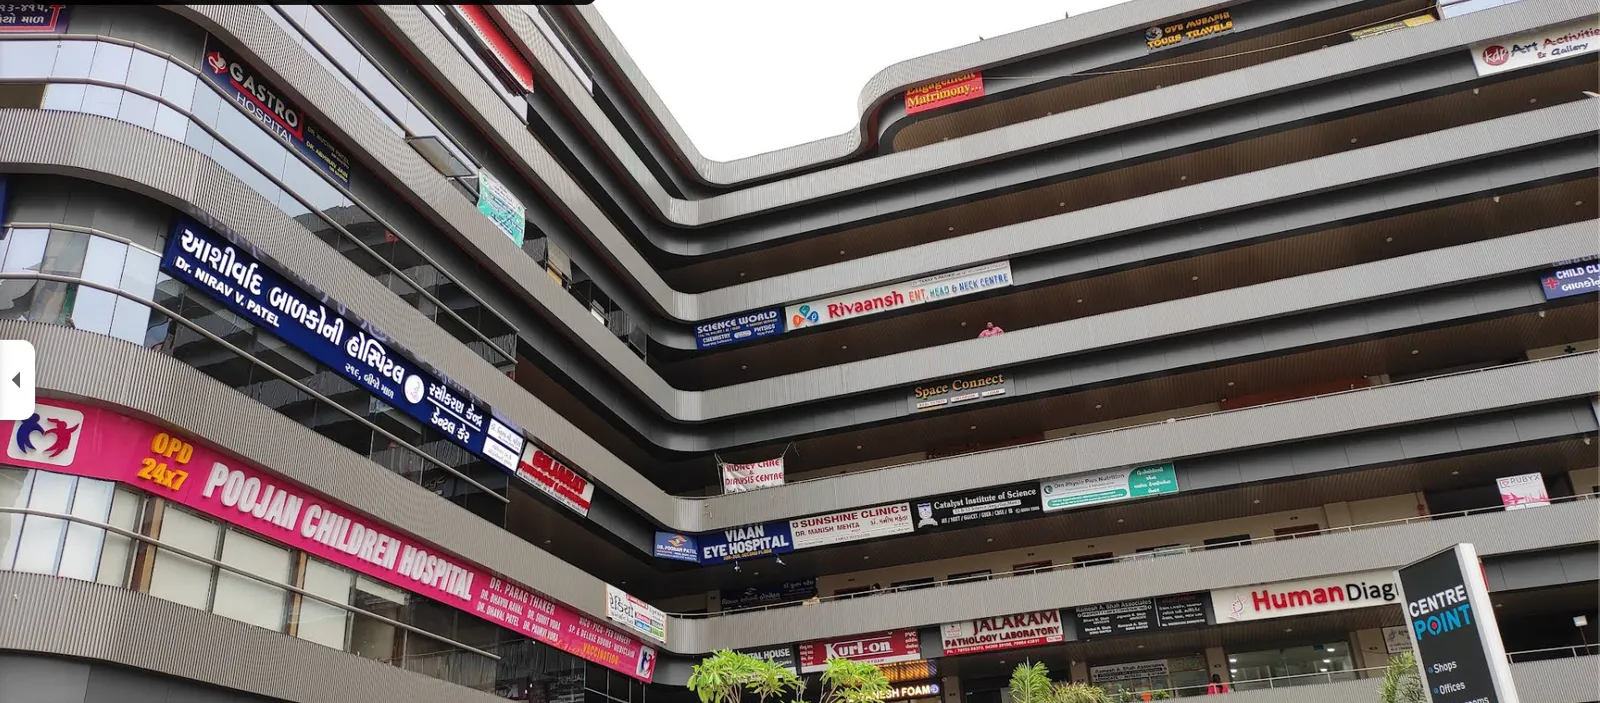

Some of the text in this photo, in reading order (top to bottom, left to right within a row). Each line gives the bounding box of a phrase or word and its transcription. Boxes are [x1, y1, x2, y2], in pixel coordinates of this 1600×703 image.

[21, 16, 44, 24] માળ
[1147, 21, 1233, 48] TOURS TRAVELS
[1511, 41, 1538, 57] Art
[1551, 43, 1588, 56] Gallery
[229, 62, 298, 128] GASTRO
[236, 91, 295, 149] HOSPITAL
[1556, 267, 1584, 279] CHILD
[175, 256, 280, 327] Dr. NIRAV V. PATEL
[1561, 276, 1600, 291] બાળકો
[827, 291, 904, 318] Rivaansh
[929, 286, 950, 298] HEAD
[952, 284, 957, 292] &
[958, 280, 978, 291] NECK
[980, 273, 1008, 287] CENTRE
[180, 229, 405, 384] આશીર્વાદ બાળકોની હોસ્પિટલ
[697, 319, 736, 334] SCIENCE
[738, 311, 777, 325] WORLD
[702, 333, 731, 343] CHEMISTRY
[754, 324, 775, 332] PHYSICS
[380, 384, 395, 399] માળ
[915, 373, 1005, 398] Space Connect
[456, 424, 470, 444] કેર
[151, 432, 193, 464] OPD
[137, 457, 188, 491] 24x7
[755, 472, 783, 482] CENTRE
[1510, 474, 1540, 484] RUBYX
[934, 489, 1037, 510] Catalyst Institute of Science
[801, 506, 899, 528] SUNSHINE CLINIC
[202, 461, 474, 601] POOJAN CHILDREN HOSPITAL
[725, 525, 765, 542] VIAAN
[808, 526, 834, 535] MANISH
[836, 522, 860, 531] MEHTA
[703, 544, 728, 559] EYE
[729, 534, 789, 555] HOSPITAL
[480, 589, 489, 601] DR.
[490, 577, 556, 615] DR. PARAG THAKER
[1120, 599, 1152, 608] Associates
[1409, 585, 1467, 617] CENTRE
[476, 601, 486, 613] DR.
[505, 612, 519, 627] PATEL
[527, 609, 535, 620] DR.
[973, 609, 1059, 636] JALARAM
[1414, 604, 1471, 640] POINT
[522, 620, 531, 632] DR.
[597, 636, 612, 648] ROOMS
[945, 634, 998, 648] PATHOLOGY
[999, 626, 1060, 640] LABORATORY
[583, 643, 619, 665] VACCINATION
[764, 648, 790, 660] HOUSE
[824, 640, 892, 658] Kurl-on
[1433, 661, 1457, 674] Shops
[901, 686, 931, 697] FOAM
[1439, 681, 1466, 695] Offices
